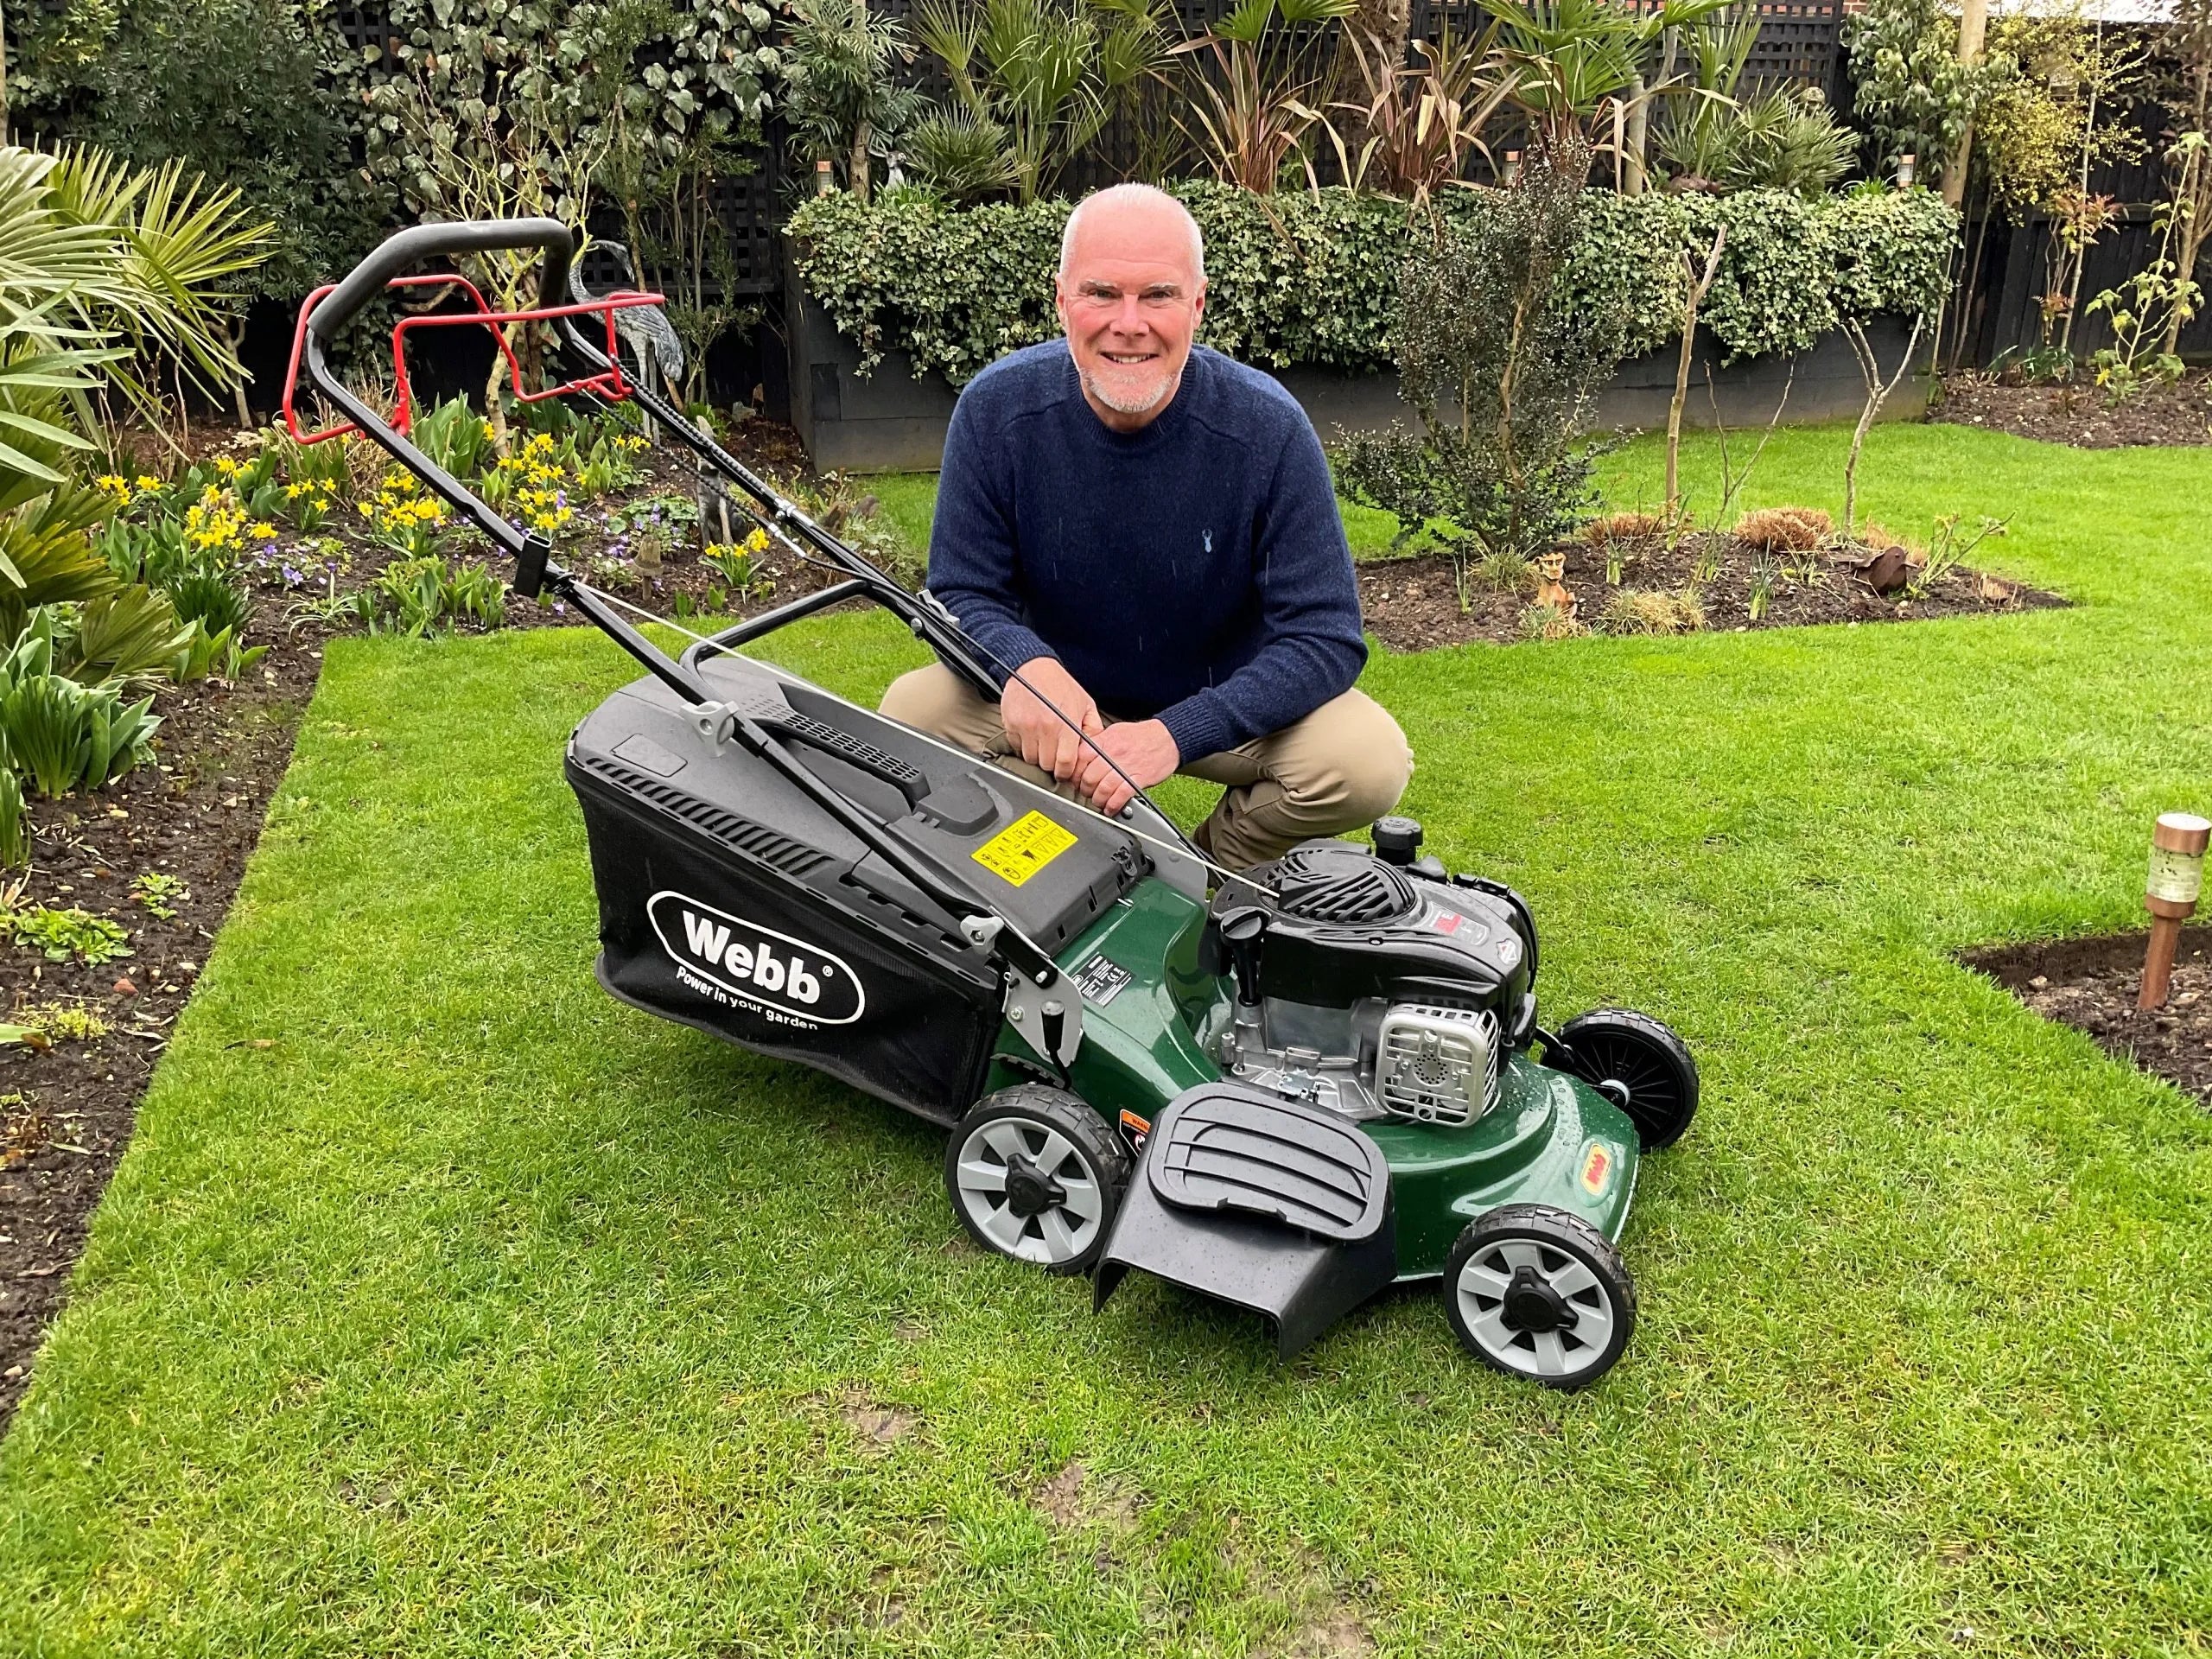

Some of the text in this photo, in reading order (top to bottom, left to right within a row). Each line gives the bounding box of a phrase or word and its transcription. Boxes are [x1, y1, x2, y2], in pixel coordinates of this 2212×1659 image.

[683, 911, 820, 1004] Webb
[676, 965, 818, 1031] Power in your garden
